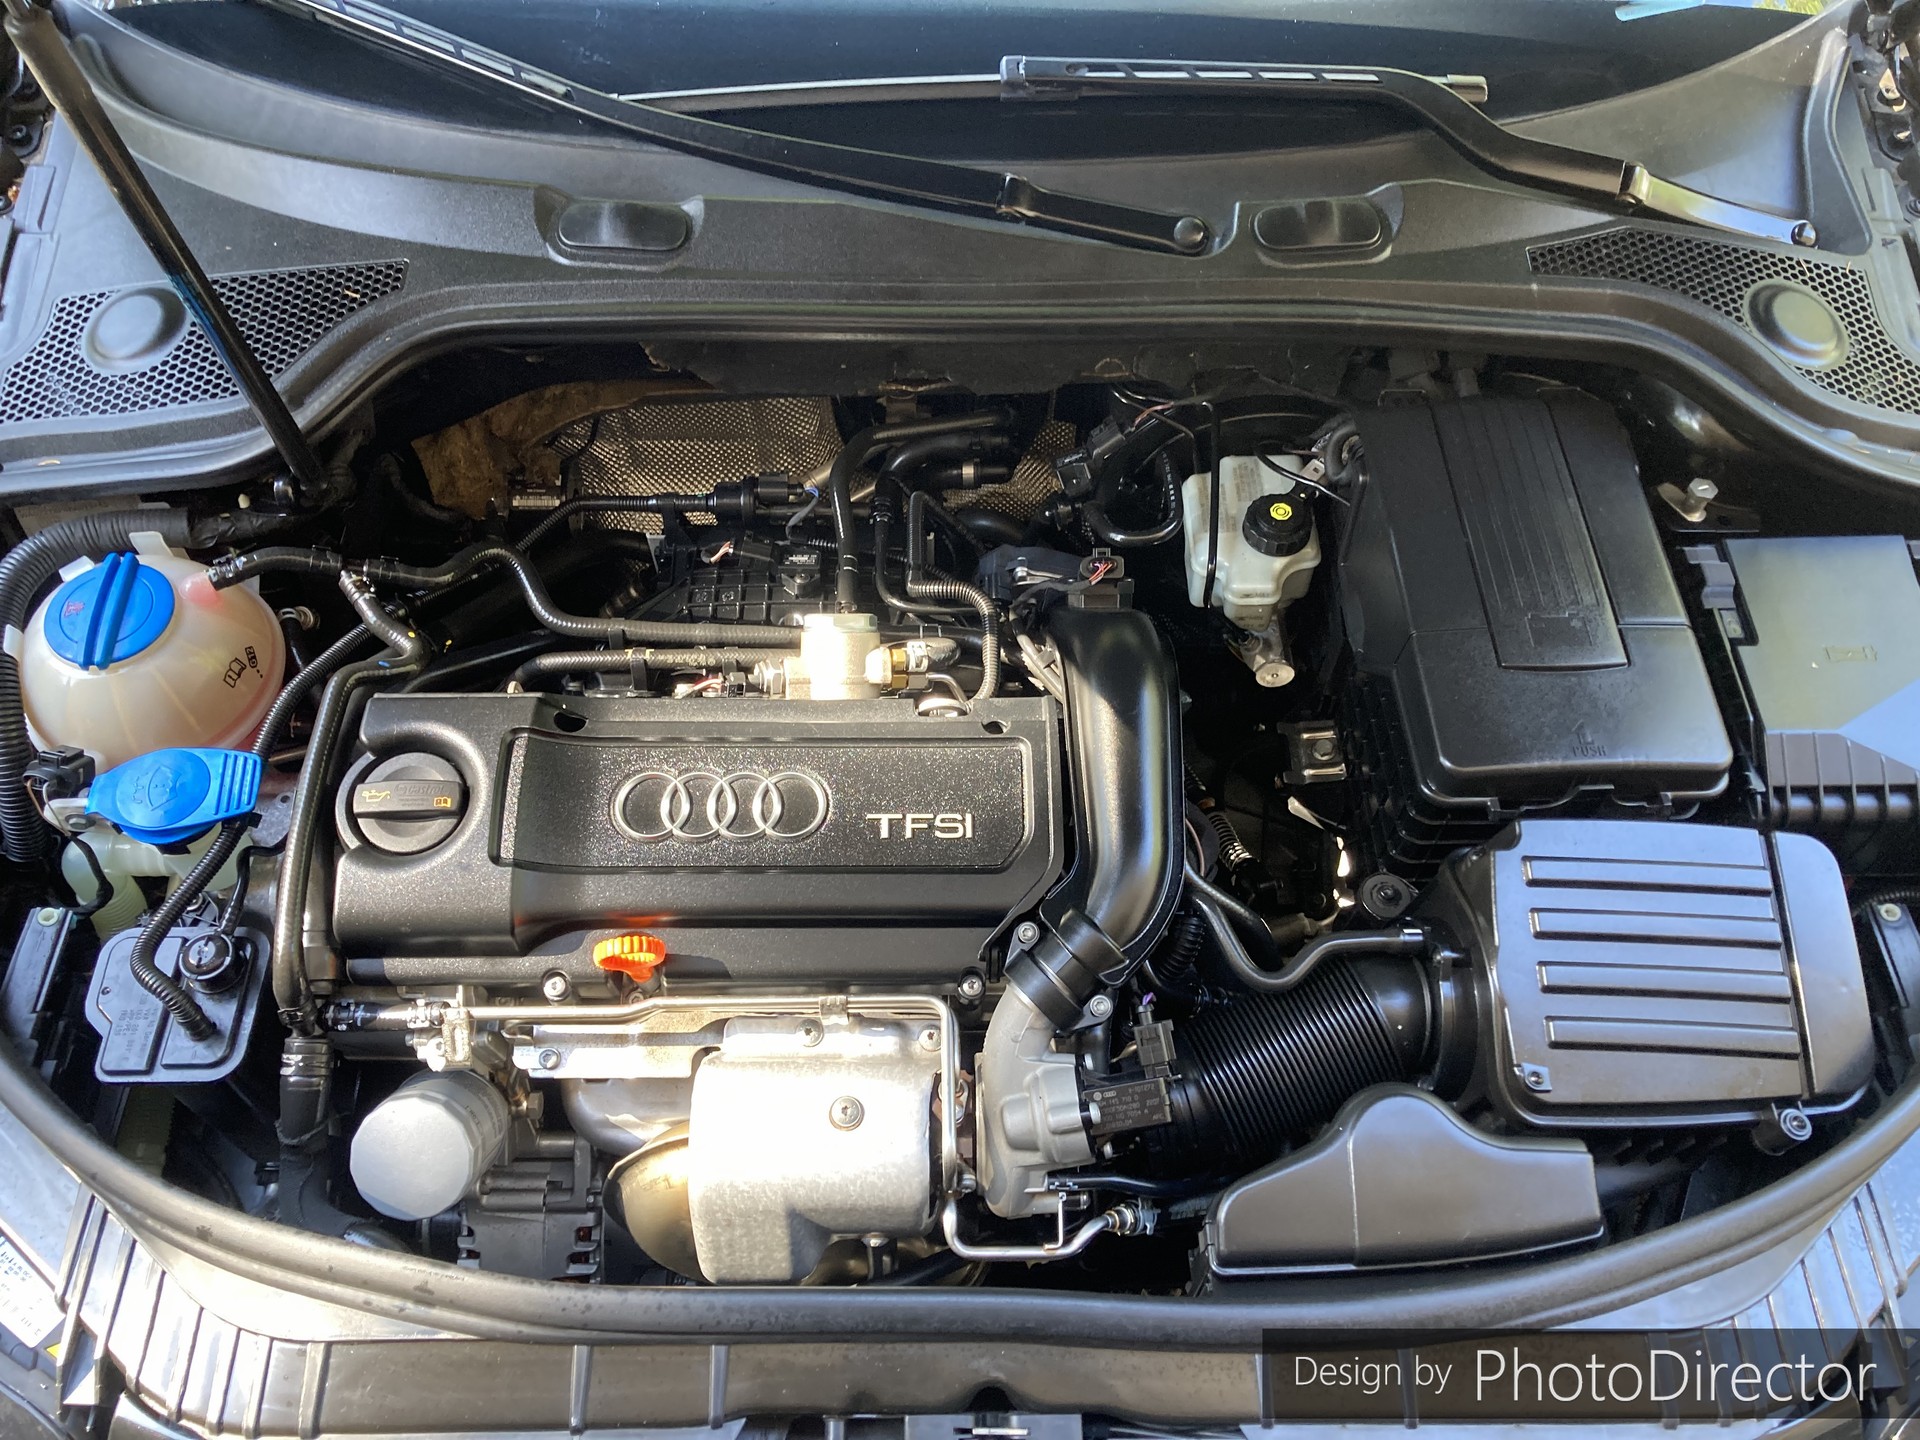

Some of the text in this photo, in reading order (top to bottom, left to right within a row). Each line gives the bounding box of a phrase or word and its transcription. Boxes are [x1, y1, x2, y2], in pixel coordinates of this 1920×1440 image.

[1572, 745, 1607, 757] PUSH
[408, 785, 445, 795] Castrol
[866, 813, 973, 839] TFSI
